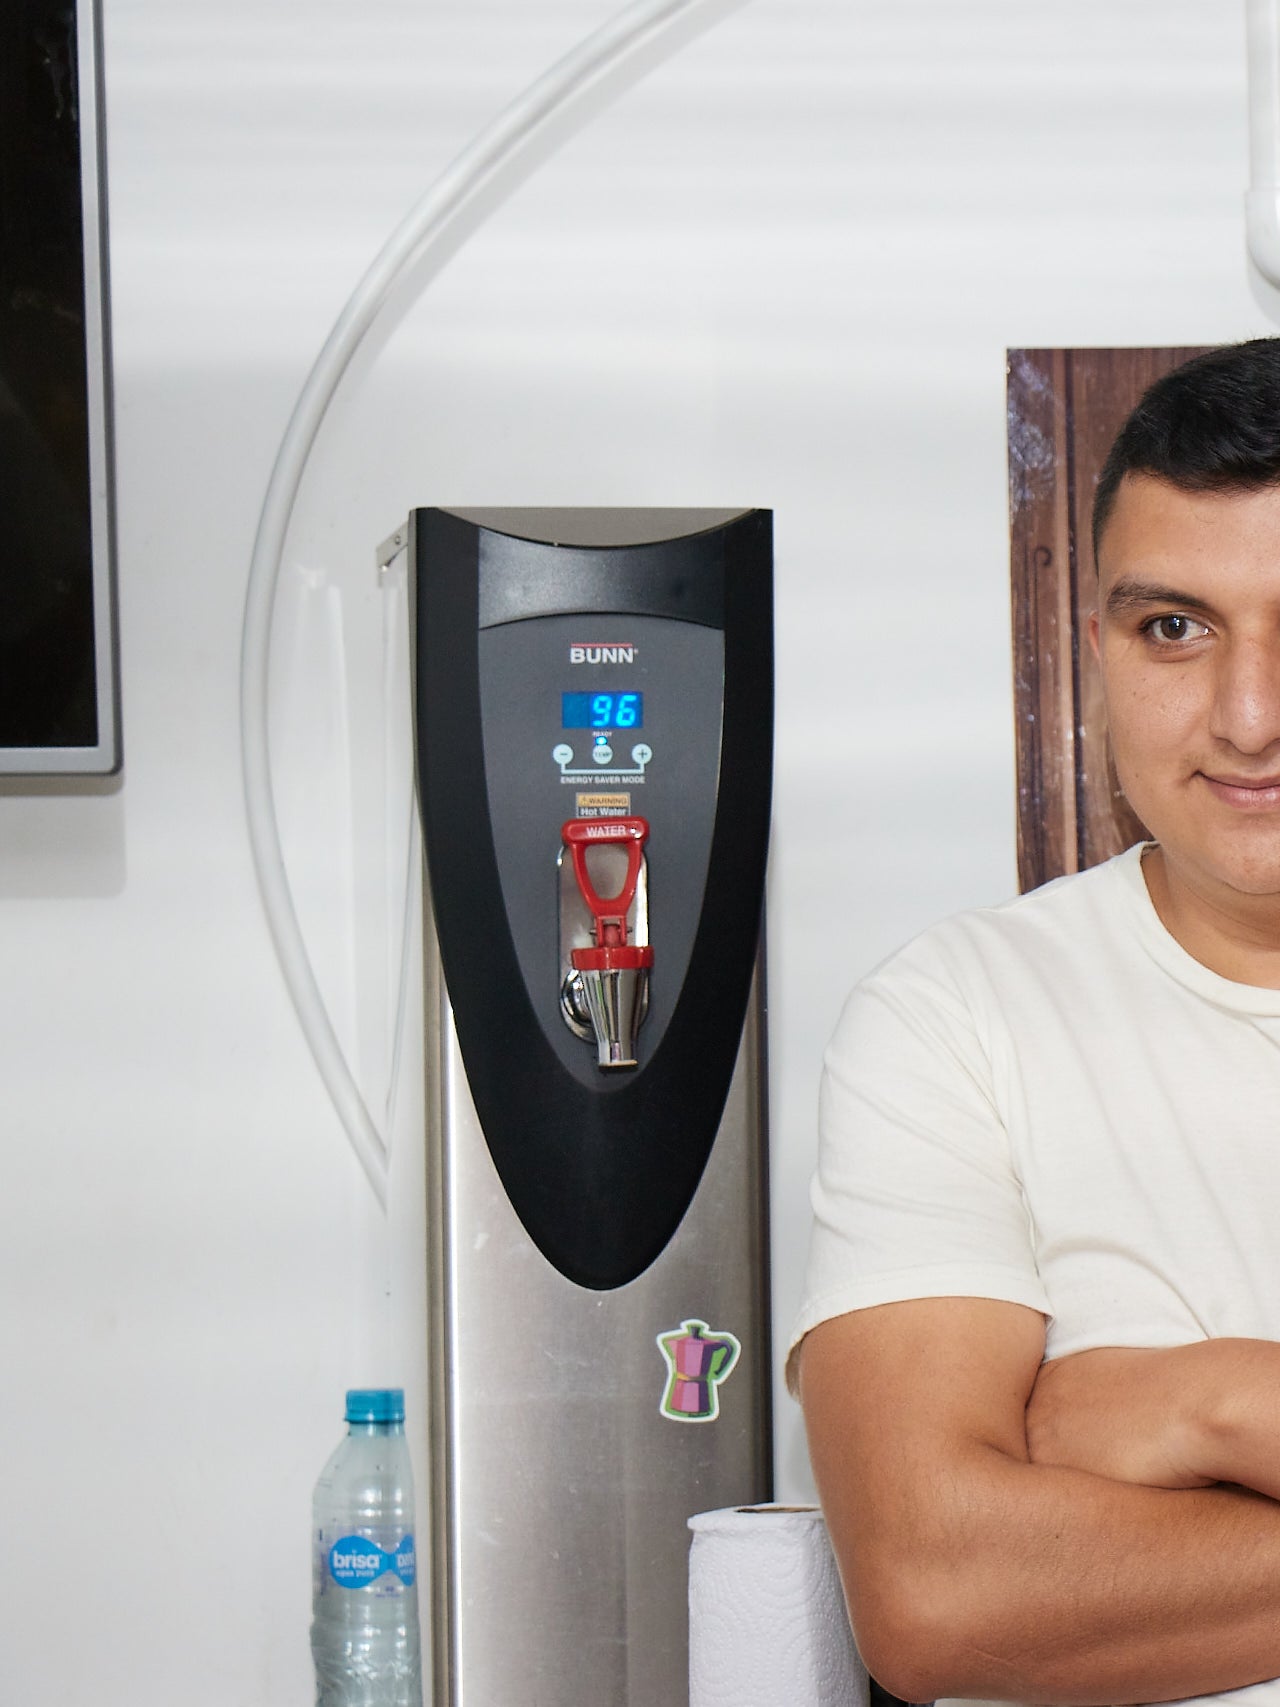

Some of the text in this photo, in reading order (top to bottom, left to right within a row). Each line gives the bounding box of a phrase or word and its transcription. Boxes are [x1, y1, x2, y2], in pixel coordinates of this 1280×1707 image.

[570, 647, 634, 664] BUNN
[592, 695, 637, 727] 96
[560, 776, 645, 784] ENERGY SAVER MODE
[589, 797, 627, 805] WARNING
[580, 807, 626, 816] Hot Water
[586, 825, 626, 838] WATER
[333, 1550, 379, 1569] brisa
